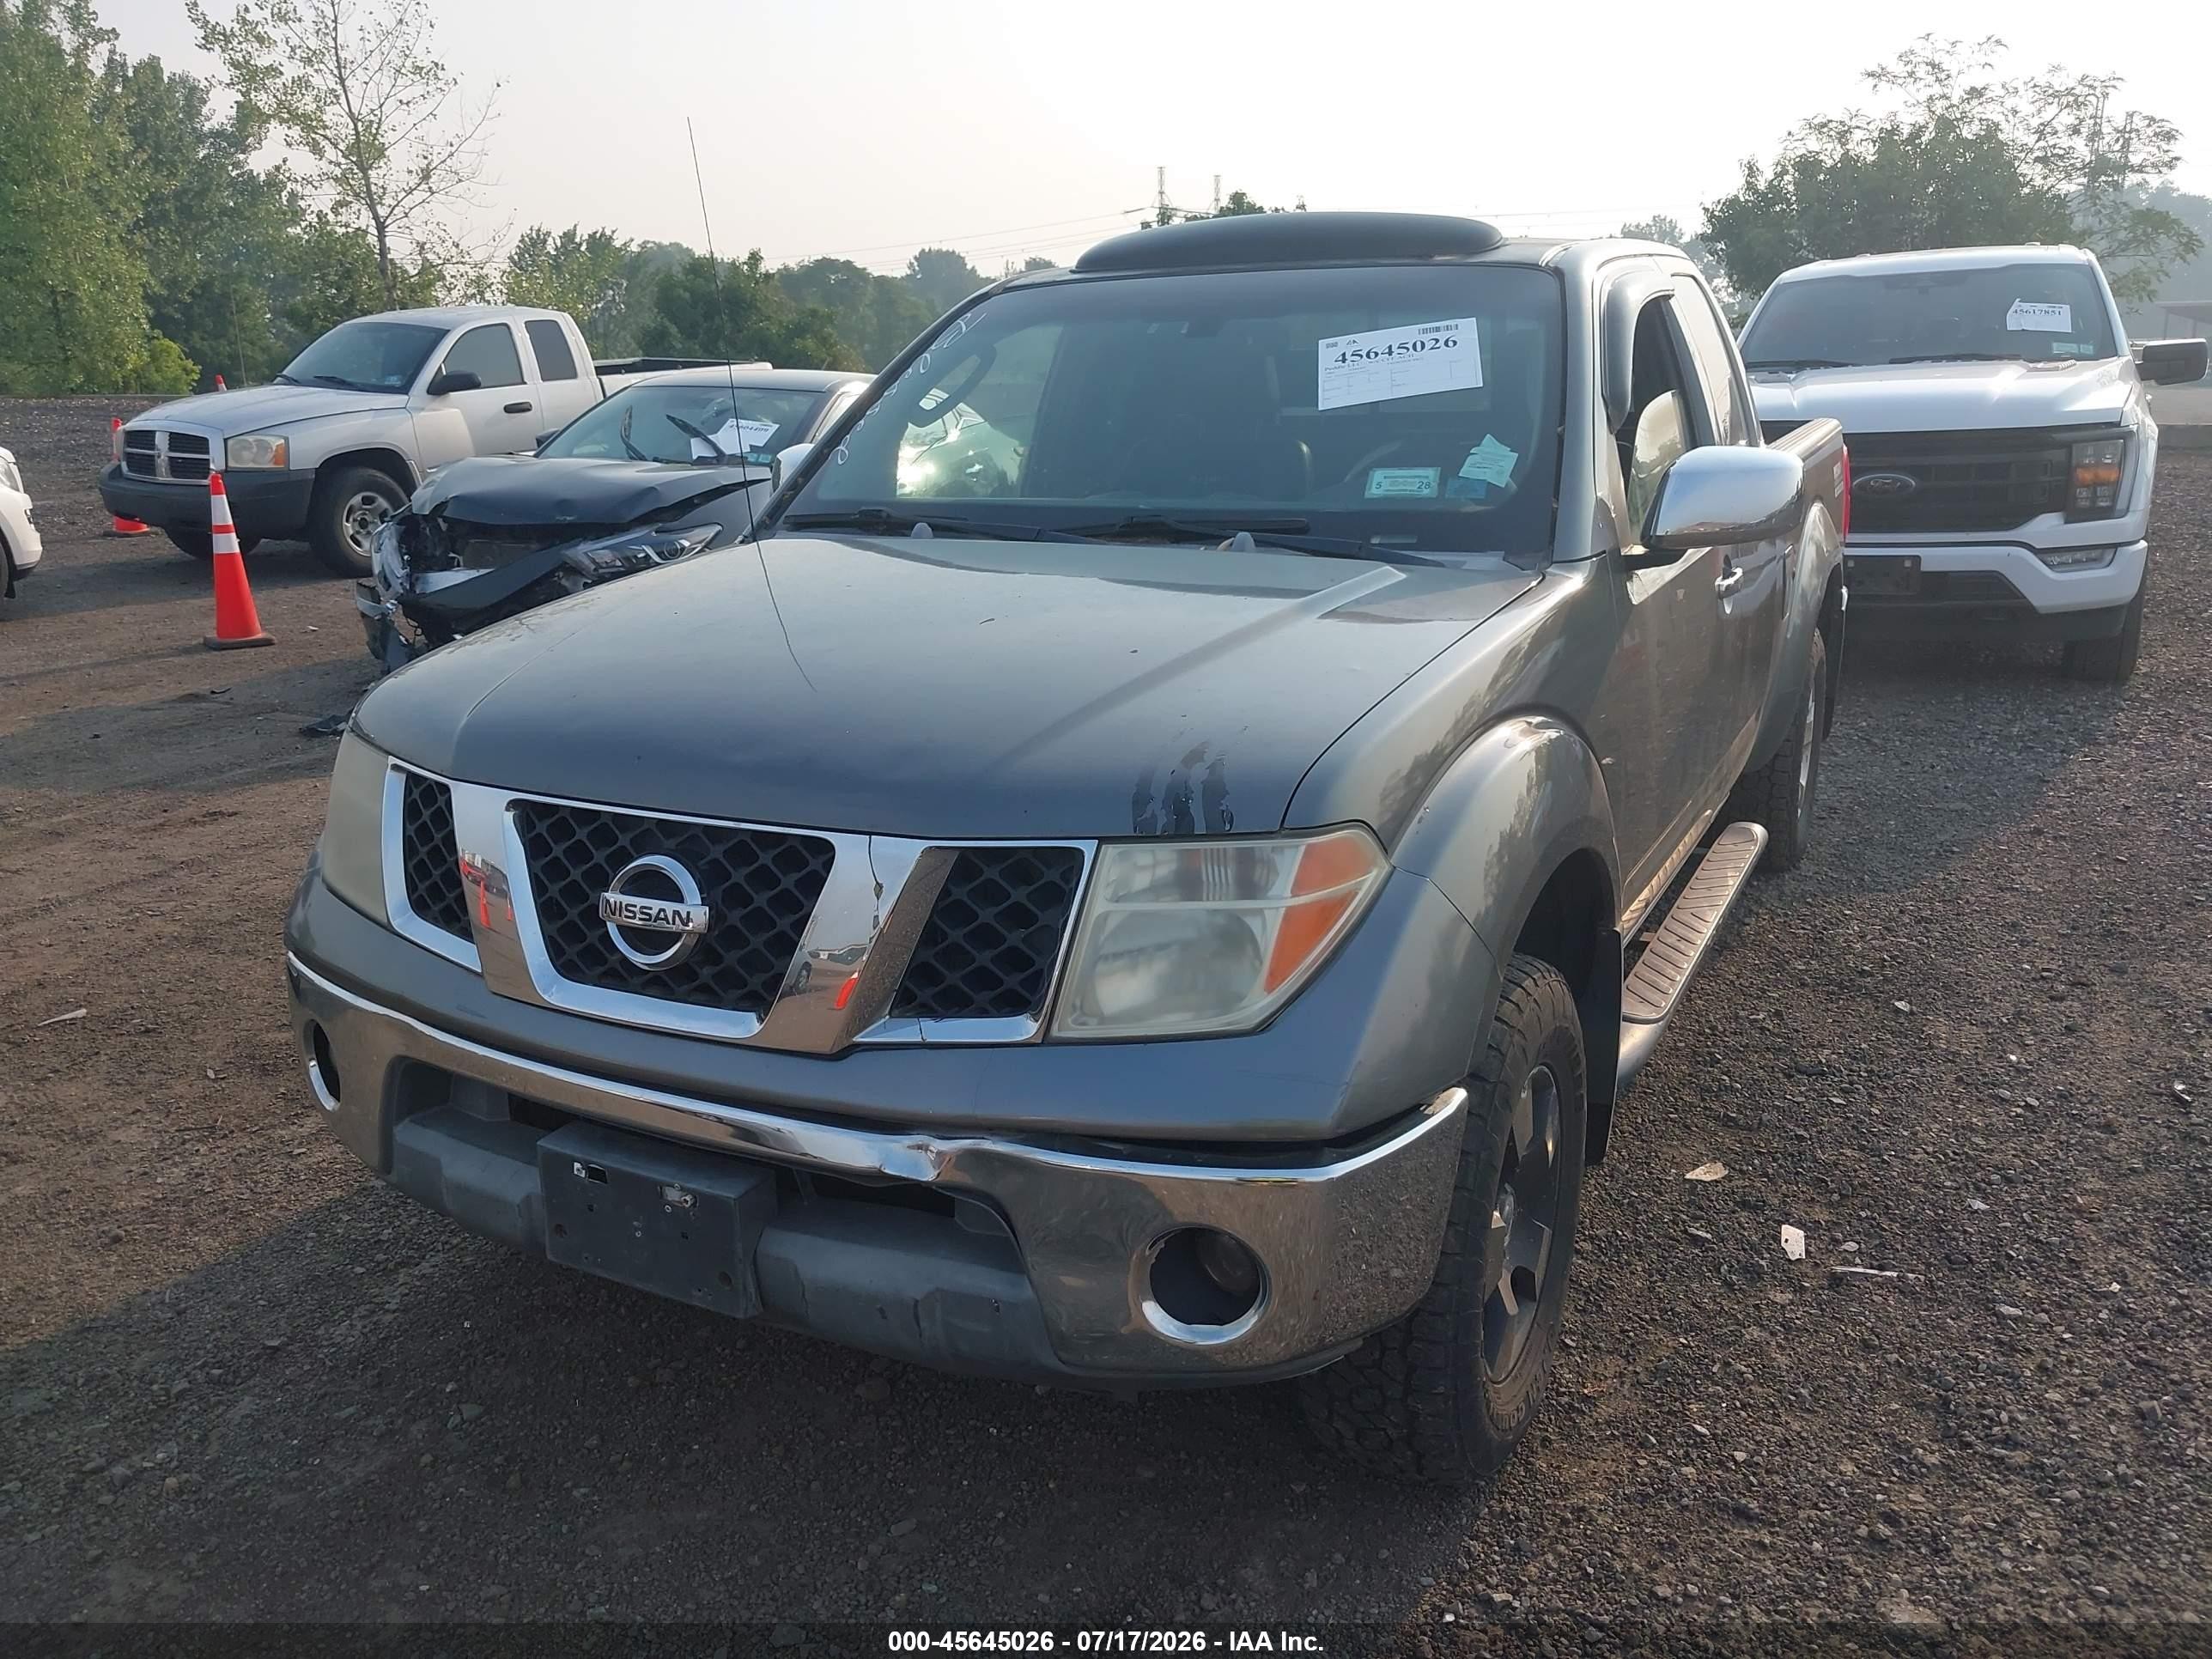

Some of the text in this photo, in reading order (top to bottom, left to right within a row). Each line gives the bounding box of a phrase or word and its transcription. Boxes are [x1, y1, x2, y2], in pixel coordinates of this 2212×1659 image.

[1334, 335, 1458, 364] 45645026
[828, 313, 987, 465] Blessed
[1375, 480, 1431, 489] 5 28
[604, 899, 691, 927] NISSAN
